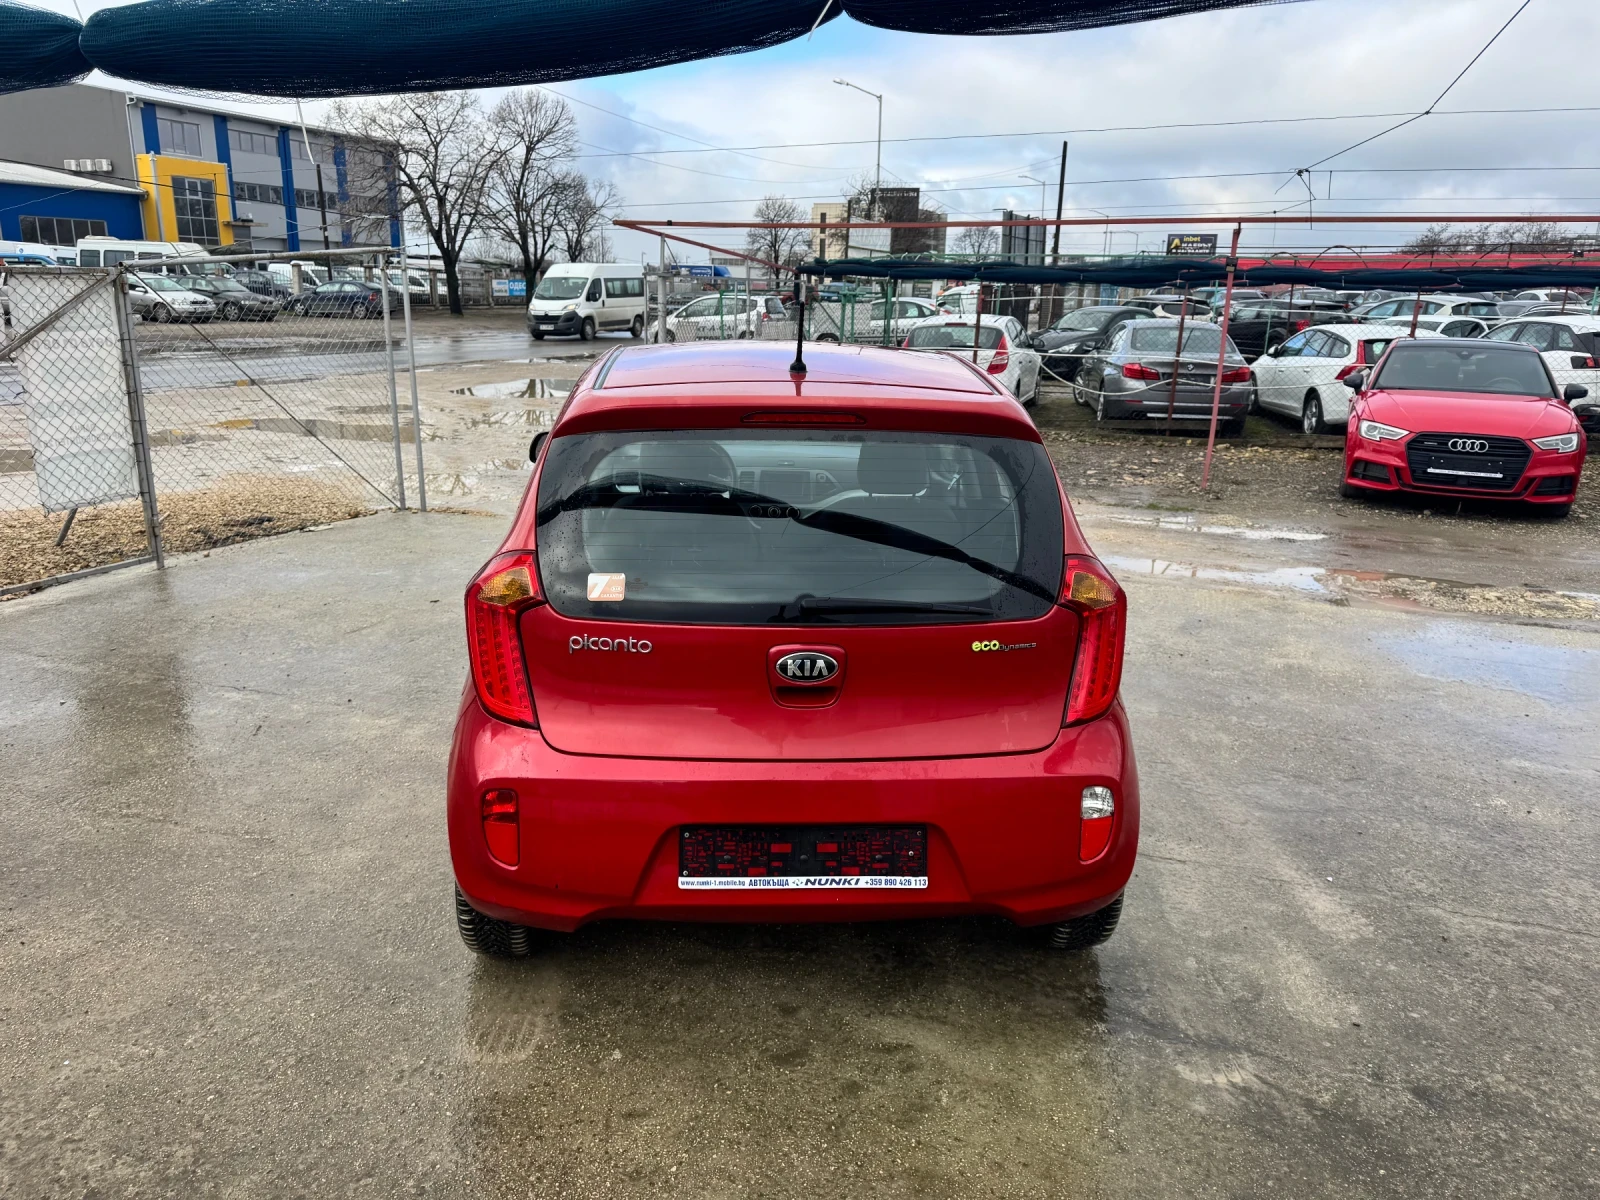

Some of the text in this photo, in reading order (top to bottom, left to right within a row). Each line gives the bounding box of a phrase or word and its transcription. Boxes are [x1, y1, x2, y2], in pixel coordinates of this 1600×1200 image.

[509, 281, 527, 291] ОДЕС
[588, 576, 611, 598] 7
[569, 633, 652, 654] picanto
[787, 659, 829, 676] KIA
[748, 878, 790, 887] АВТОКЪЩА
[804, 878, 861, 886] NUNKI
[864, 878, 927, 887] +359 890 426 113
